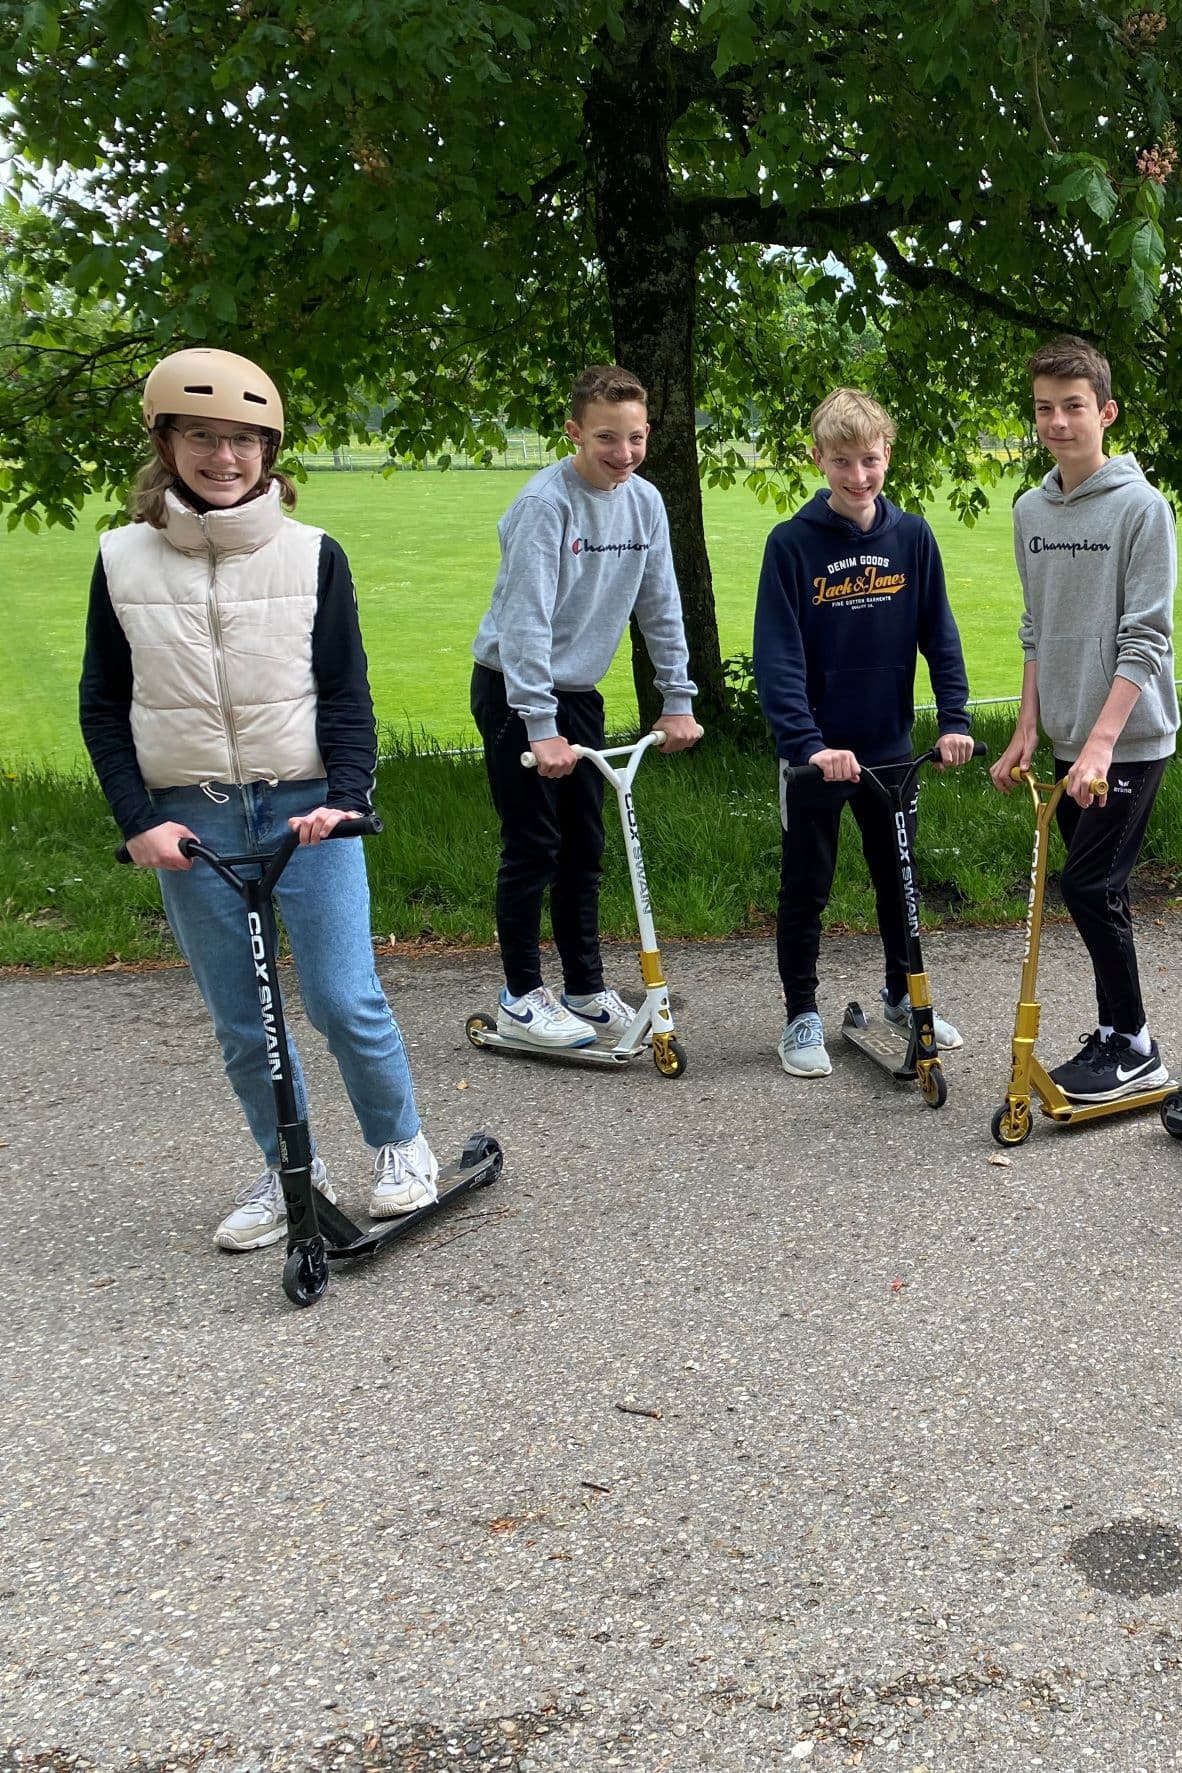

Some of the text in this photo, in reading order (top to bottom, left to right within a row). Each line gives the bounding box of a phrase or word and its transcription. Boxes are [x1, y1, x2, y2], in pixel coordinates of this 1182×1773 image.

[572, 537, 649, 558] Champion
[1029, 536, 1111, 558] Champion
[827, 555, 889, 574] DENIM GOODS
[894, 811, 920, 938] COX SWAIN
[248, 911, 284, 1081] COX SWAIN
